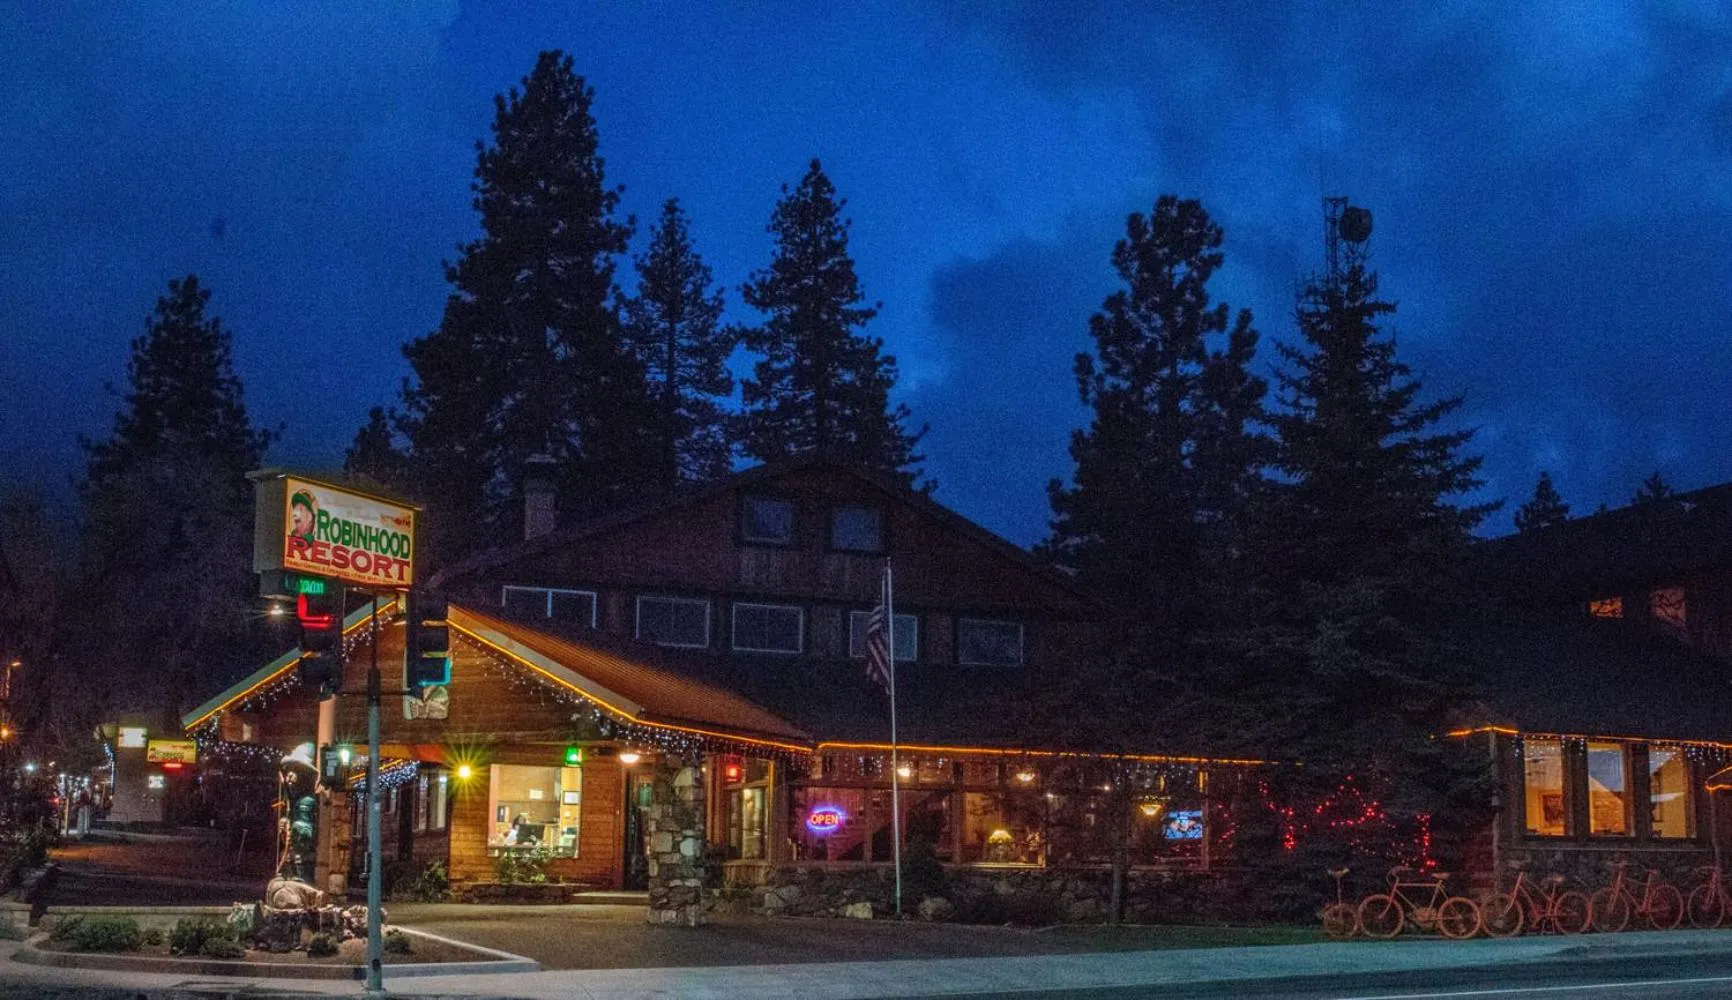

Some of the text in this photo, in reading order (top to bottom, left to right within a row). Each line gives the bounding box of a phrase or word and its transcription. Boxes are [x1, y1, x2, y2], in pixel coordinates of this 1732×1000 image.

[317, 509, 411, 559] ROBINHOOD
[286, 535, 411, 580] RESORT
[811, 814, 838, 825] OPEN
